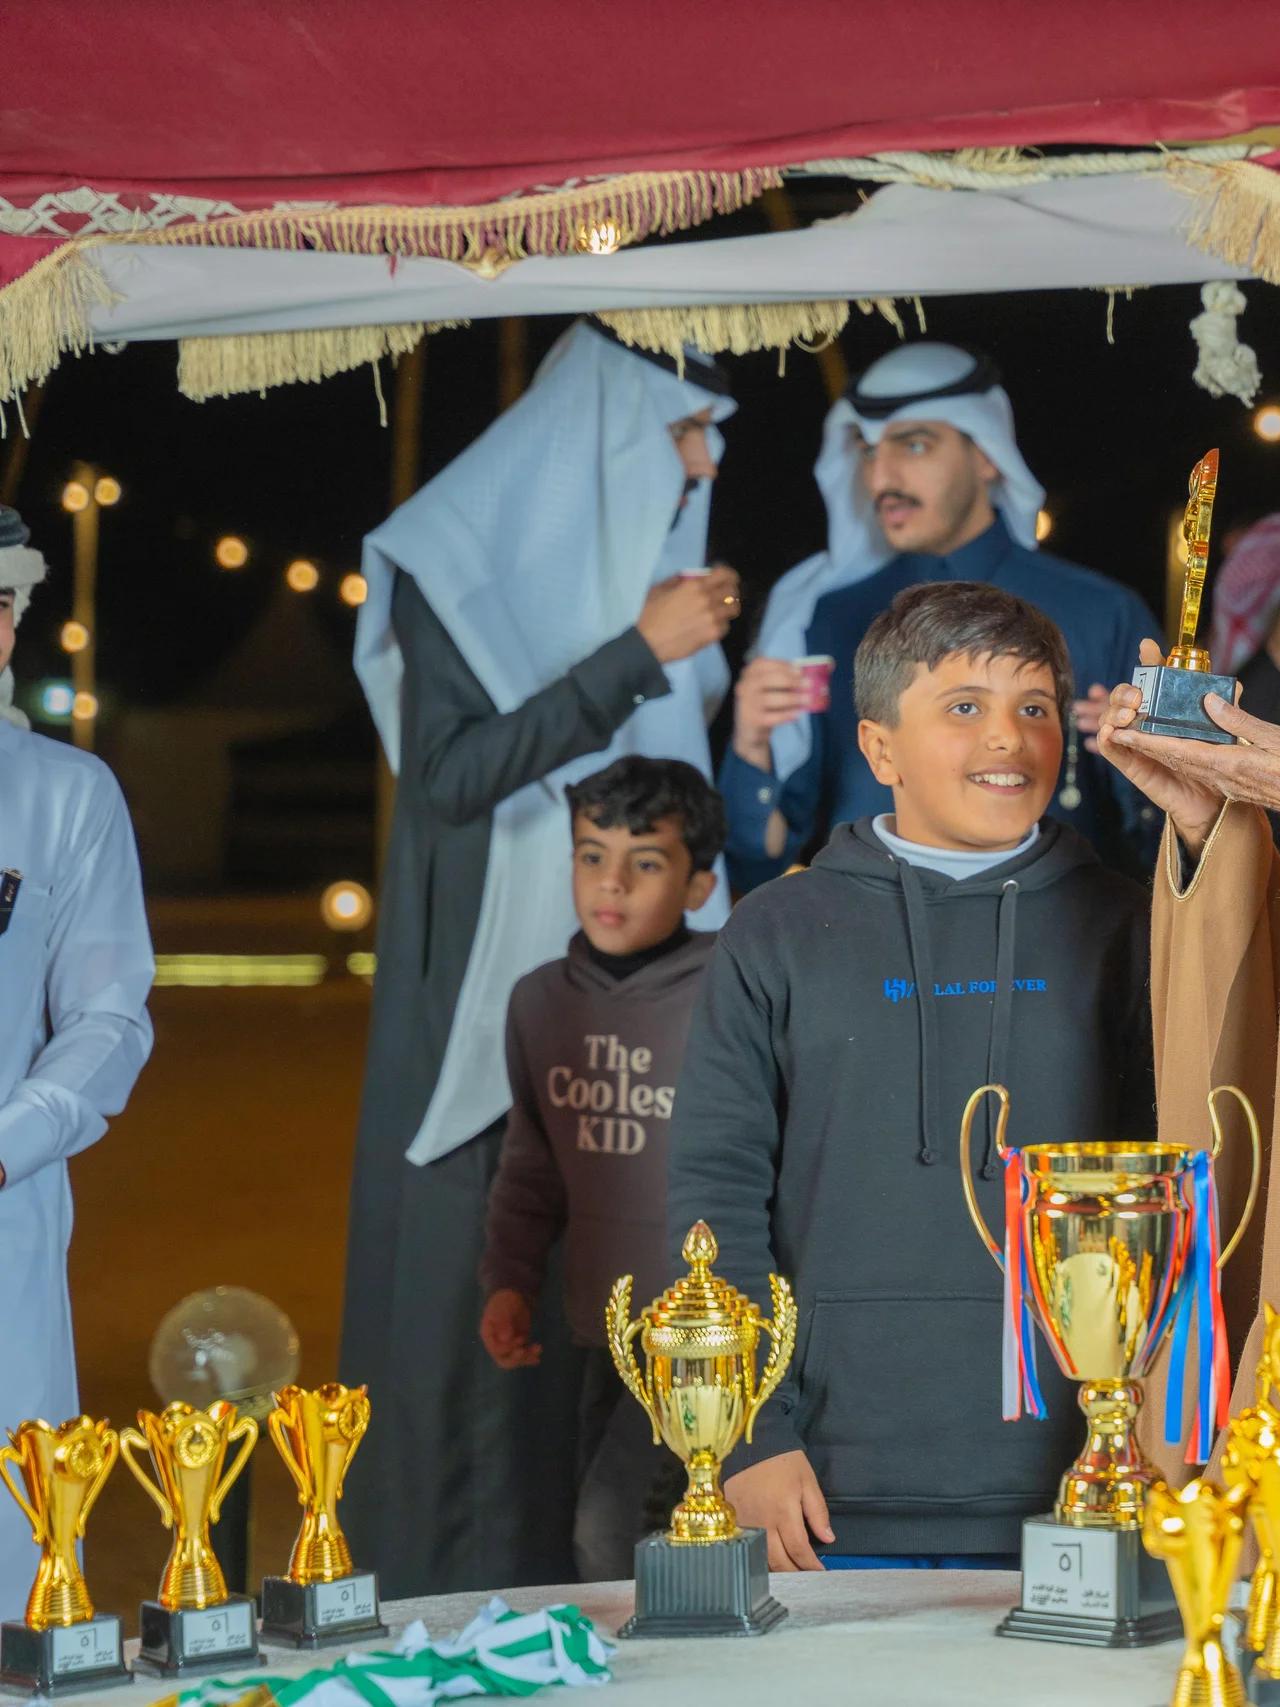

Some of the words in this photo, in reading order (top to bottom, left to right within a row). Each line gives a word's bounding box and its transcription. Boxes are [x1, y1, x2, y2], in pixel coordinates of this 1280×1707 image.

[967, 978, 1048, 995] FOVER
[584, 1033, 652, 1074] The
[547, 1066, 677, 1120] Cooles
[576, 1114, 647, 1156] KID
